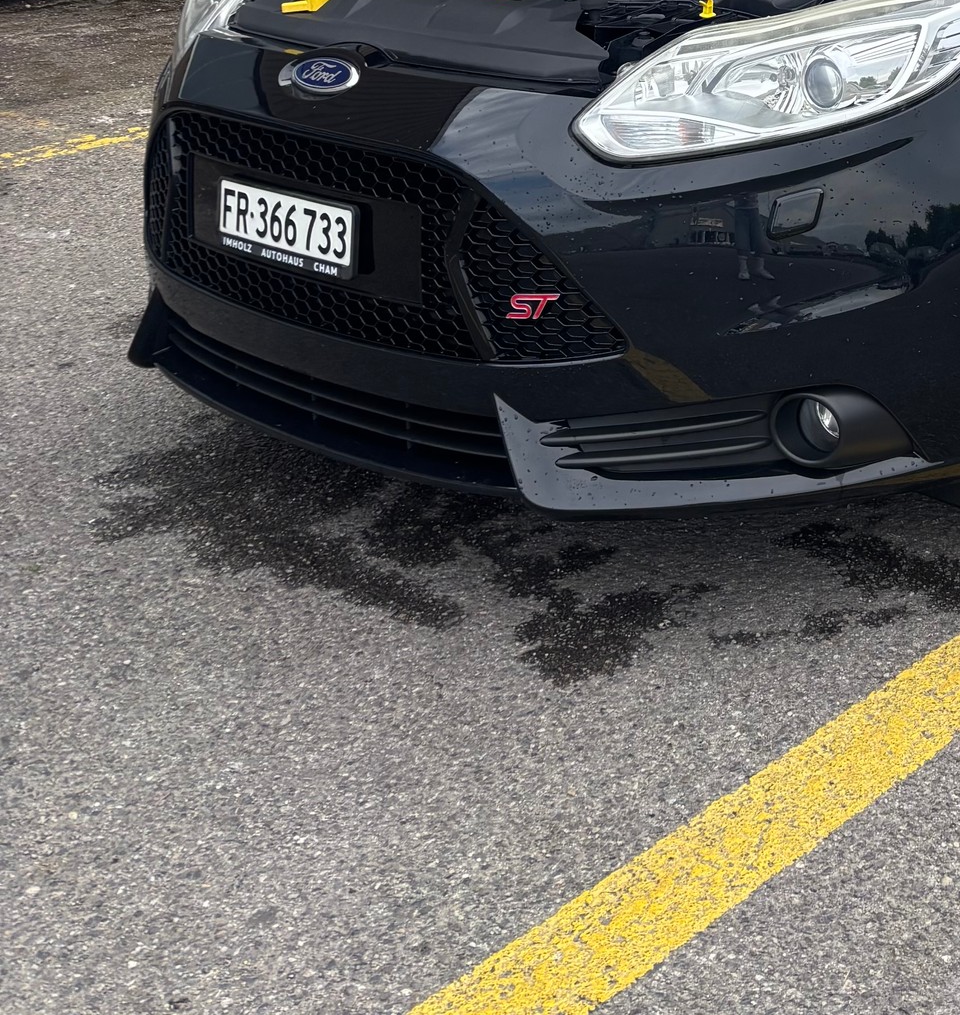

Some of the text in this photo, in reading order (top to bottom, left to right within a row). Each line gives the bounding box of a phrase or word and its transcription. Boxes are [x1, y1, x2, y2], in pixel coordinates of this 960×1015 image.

[302, 61, 342, 84] Ford
[303, 207, 348, 259] 733
[222, 236, 338, 276] IMHOLZ AUTOHAUS CHAM
[505, 293, 561, 320] ST
